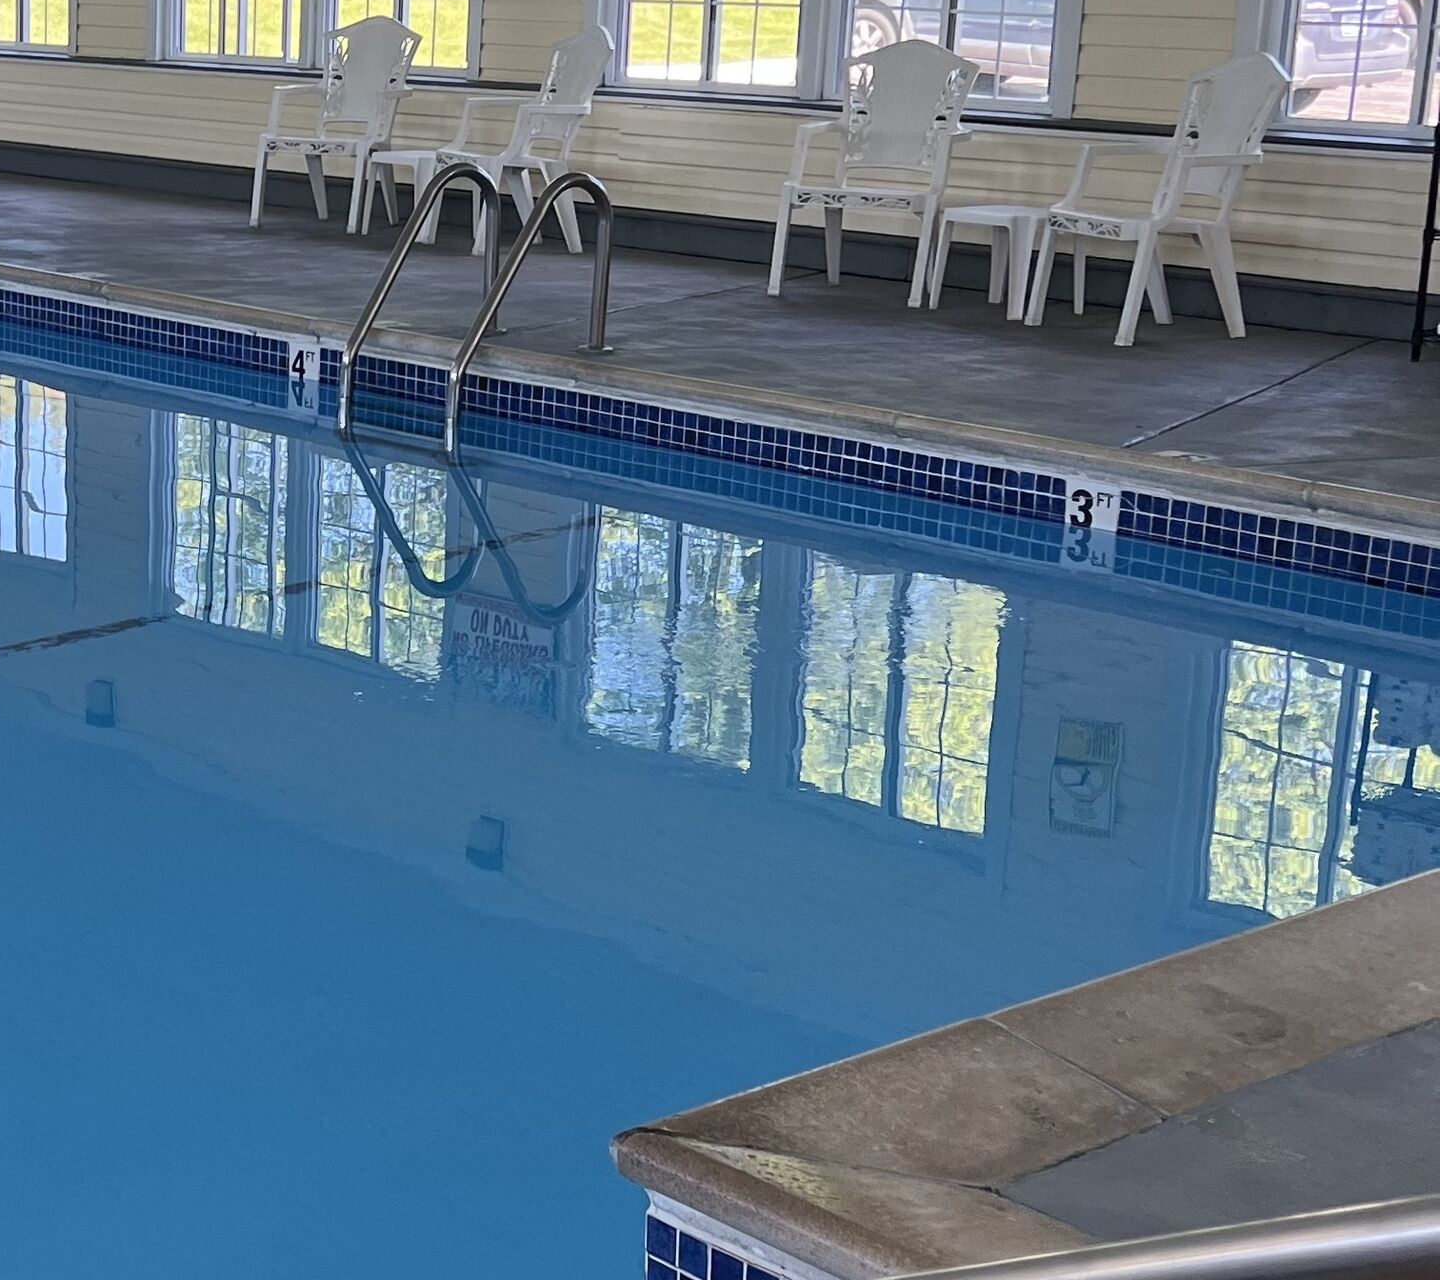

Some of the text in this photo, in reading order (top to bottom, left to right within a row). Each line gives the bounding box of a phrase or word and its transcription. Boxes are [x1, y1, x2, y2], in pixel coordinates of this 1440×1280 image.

[291, 350, 316, 380] 4 FT
[1069, 489, 1114, 528] 3 FT
